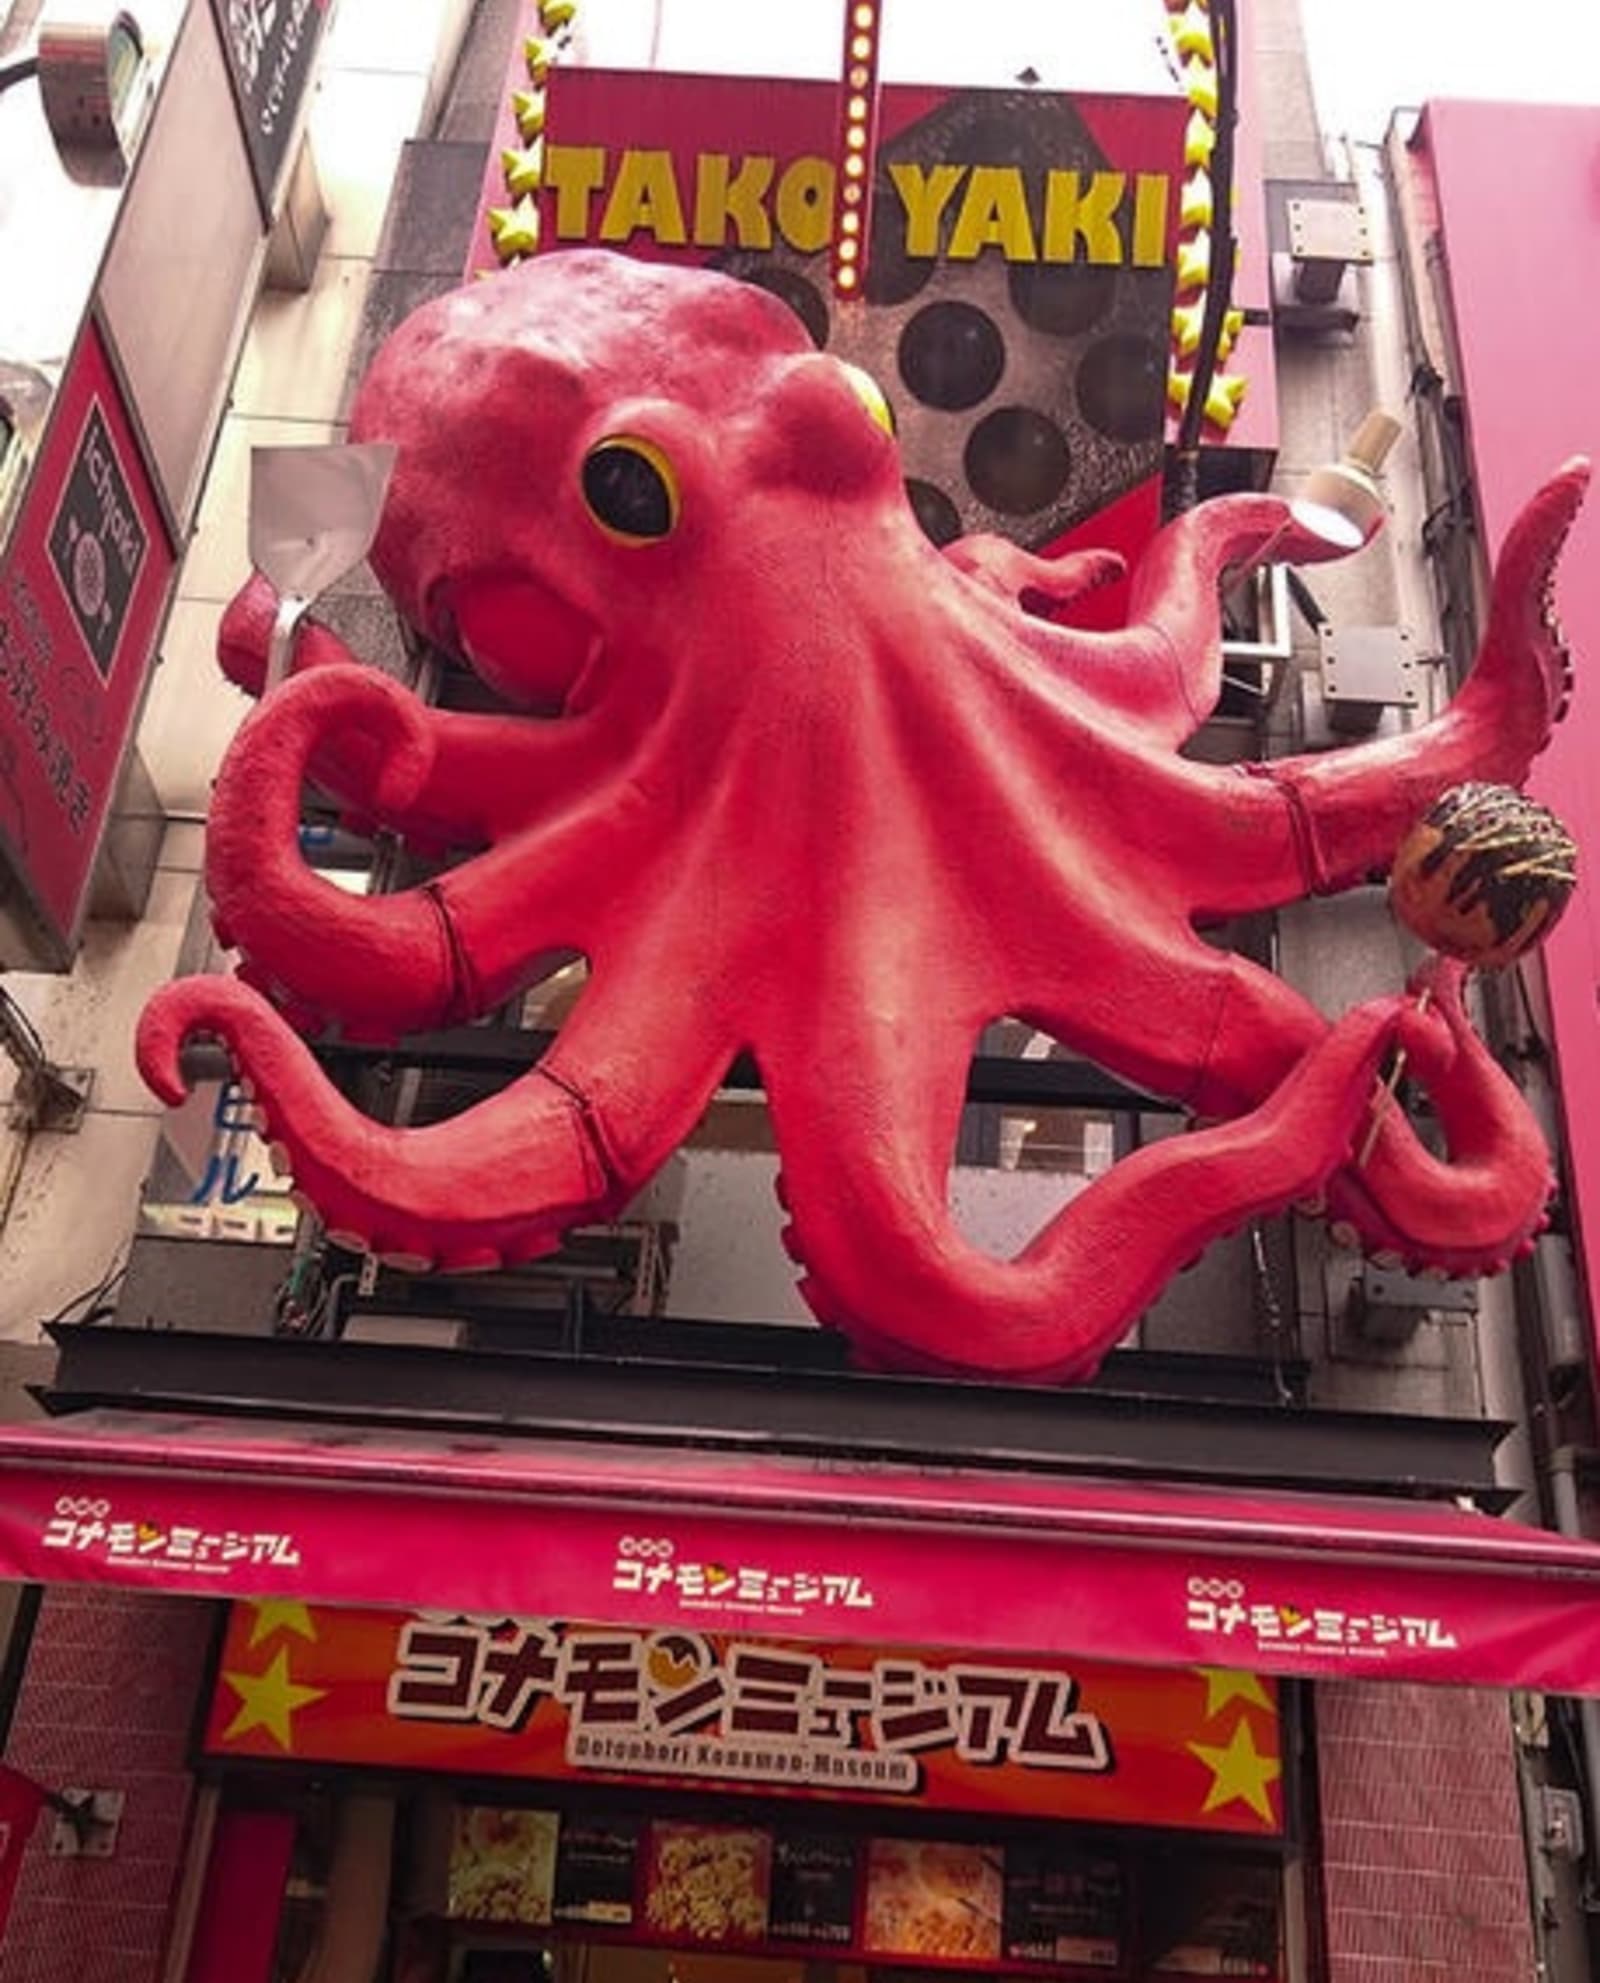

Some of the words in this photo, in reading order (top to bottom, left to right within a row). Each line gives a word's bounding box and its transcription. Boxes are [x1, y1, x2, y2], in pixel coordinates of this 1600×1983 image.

[546, 146, 838, 253] TAKO
[888, 163, 1170, 267] YAKI
[43, 1519, 299, 1565] コナモンミュージアム
[612, 1560, 874, 1607] コナモンミュージアム
[1187, 1600, 1458, 1648] コナモンミュージアム
[390, 1625, 1110, 1768] コナモンミュージアム
